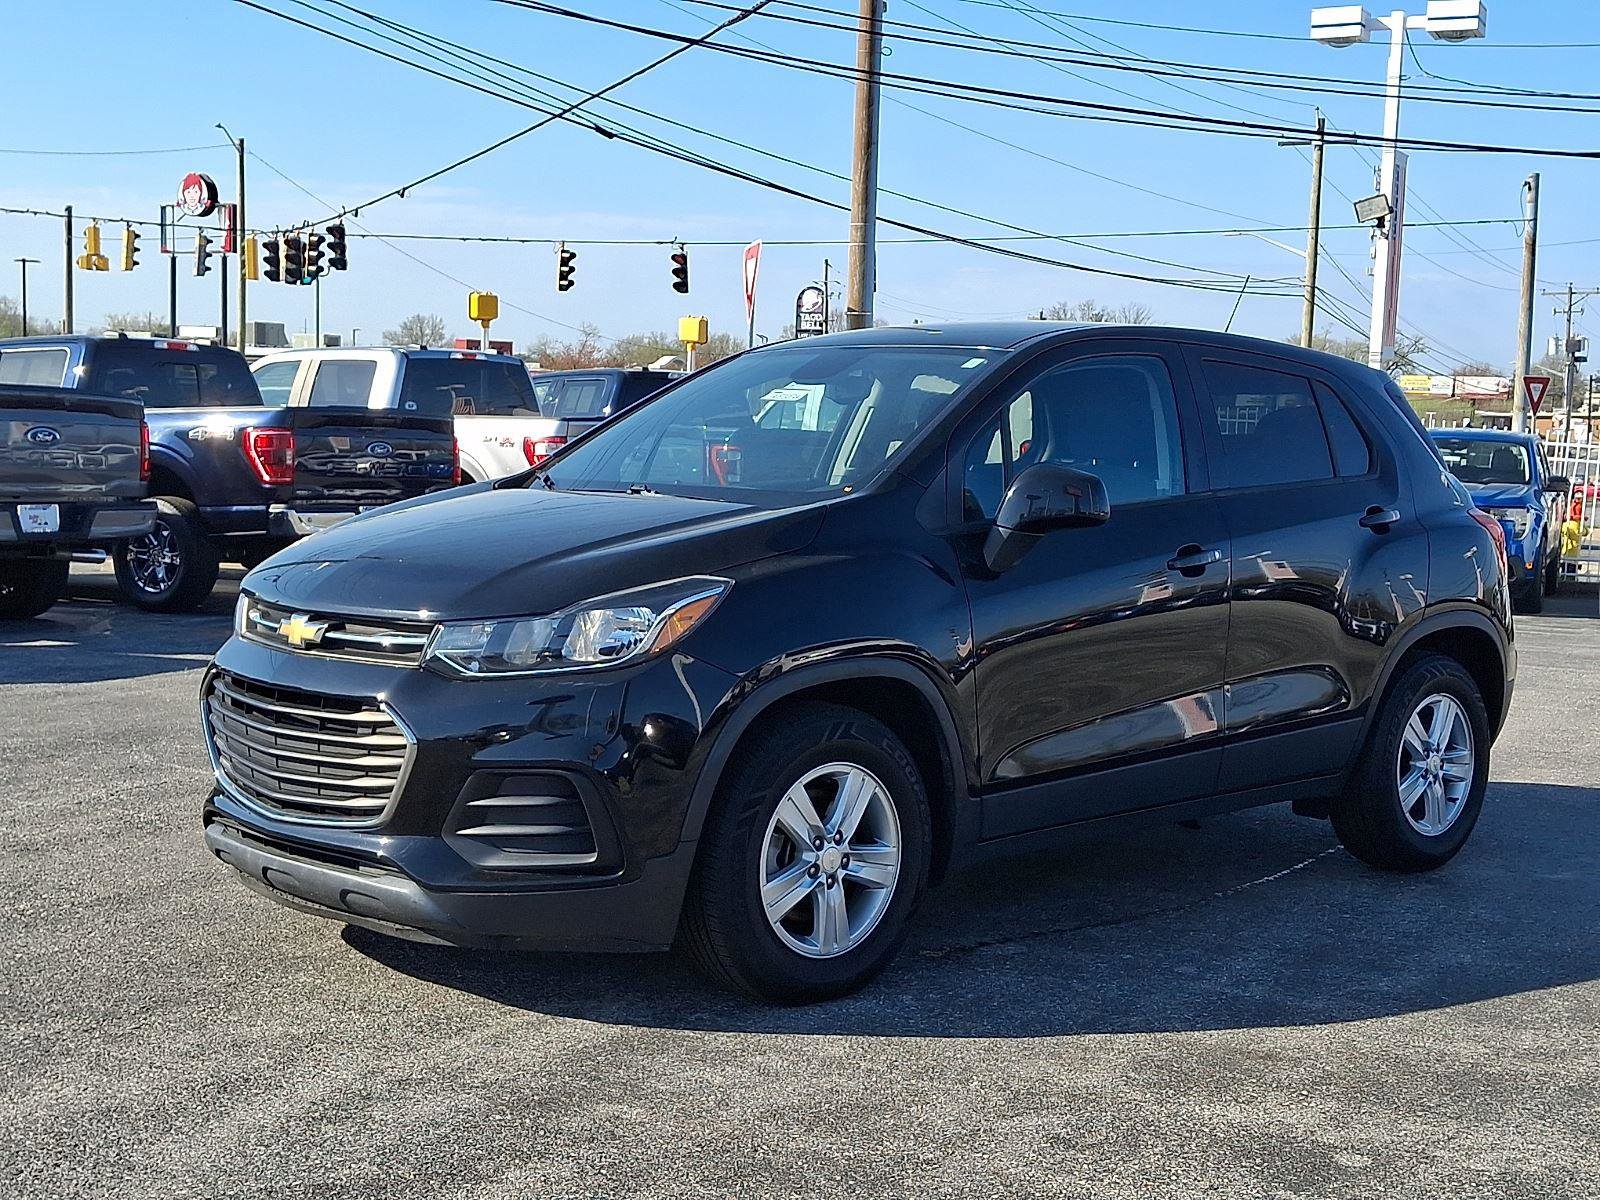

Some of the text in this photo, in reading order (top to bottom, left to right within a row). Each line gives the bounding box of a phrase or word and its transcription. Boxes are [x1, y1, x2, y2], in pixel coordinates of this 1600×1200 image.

[800, 313, 823, 321] TACO
[801, 321, 823, 330] BELL
[189, 426, 235, 441] 44
